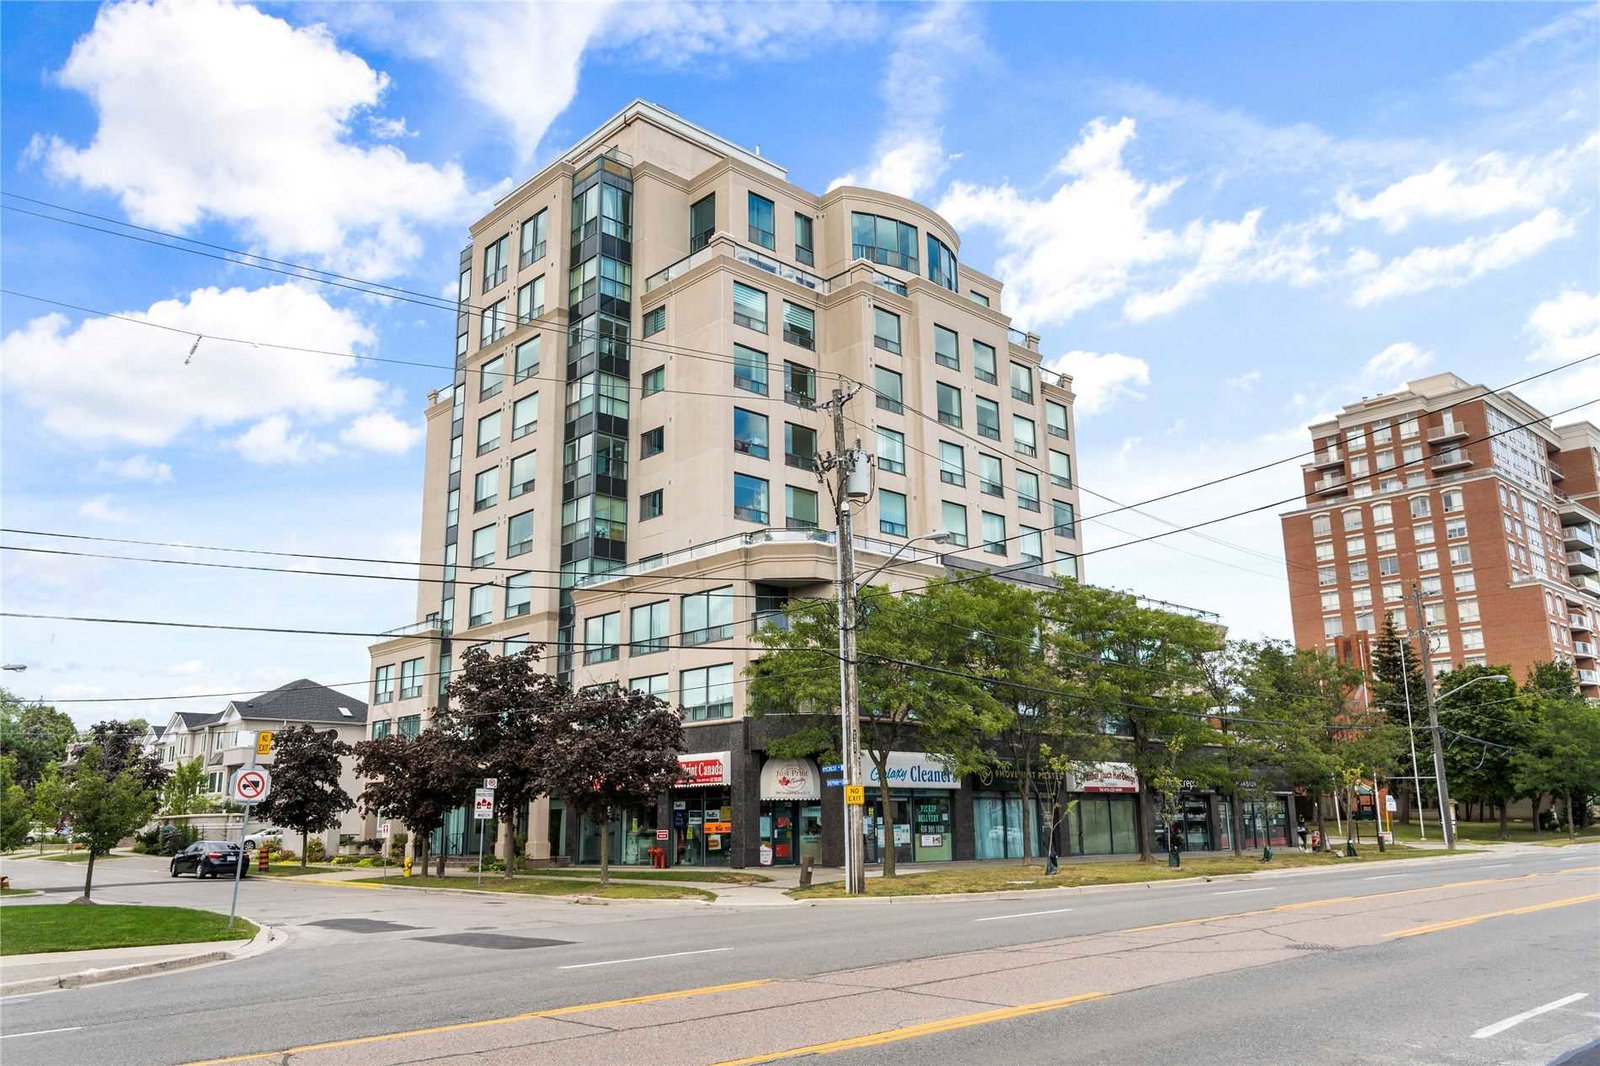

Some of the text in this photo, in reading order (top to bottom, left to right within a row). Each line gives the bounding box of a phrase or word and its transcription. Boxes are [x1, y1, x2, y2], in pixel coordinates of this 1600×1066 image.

[258, 743, 269, 752] EXIT
[698, 761, 724, 776] Canada
[791, 768, 809, 777] Print
[918, 814, 939, 823] DELIVERY
